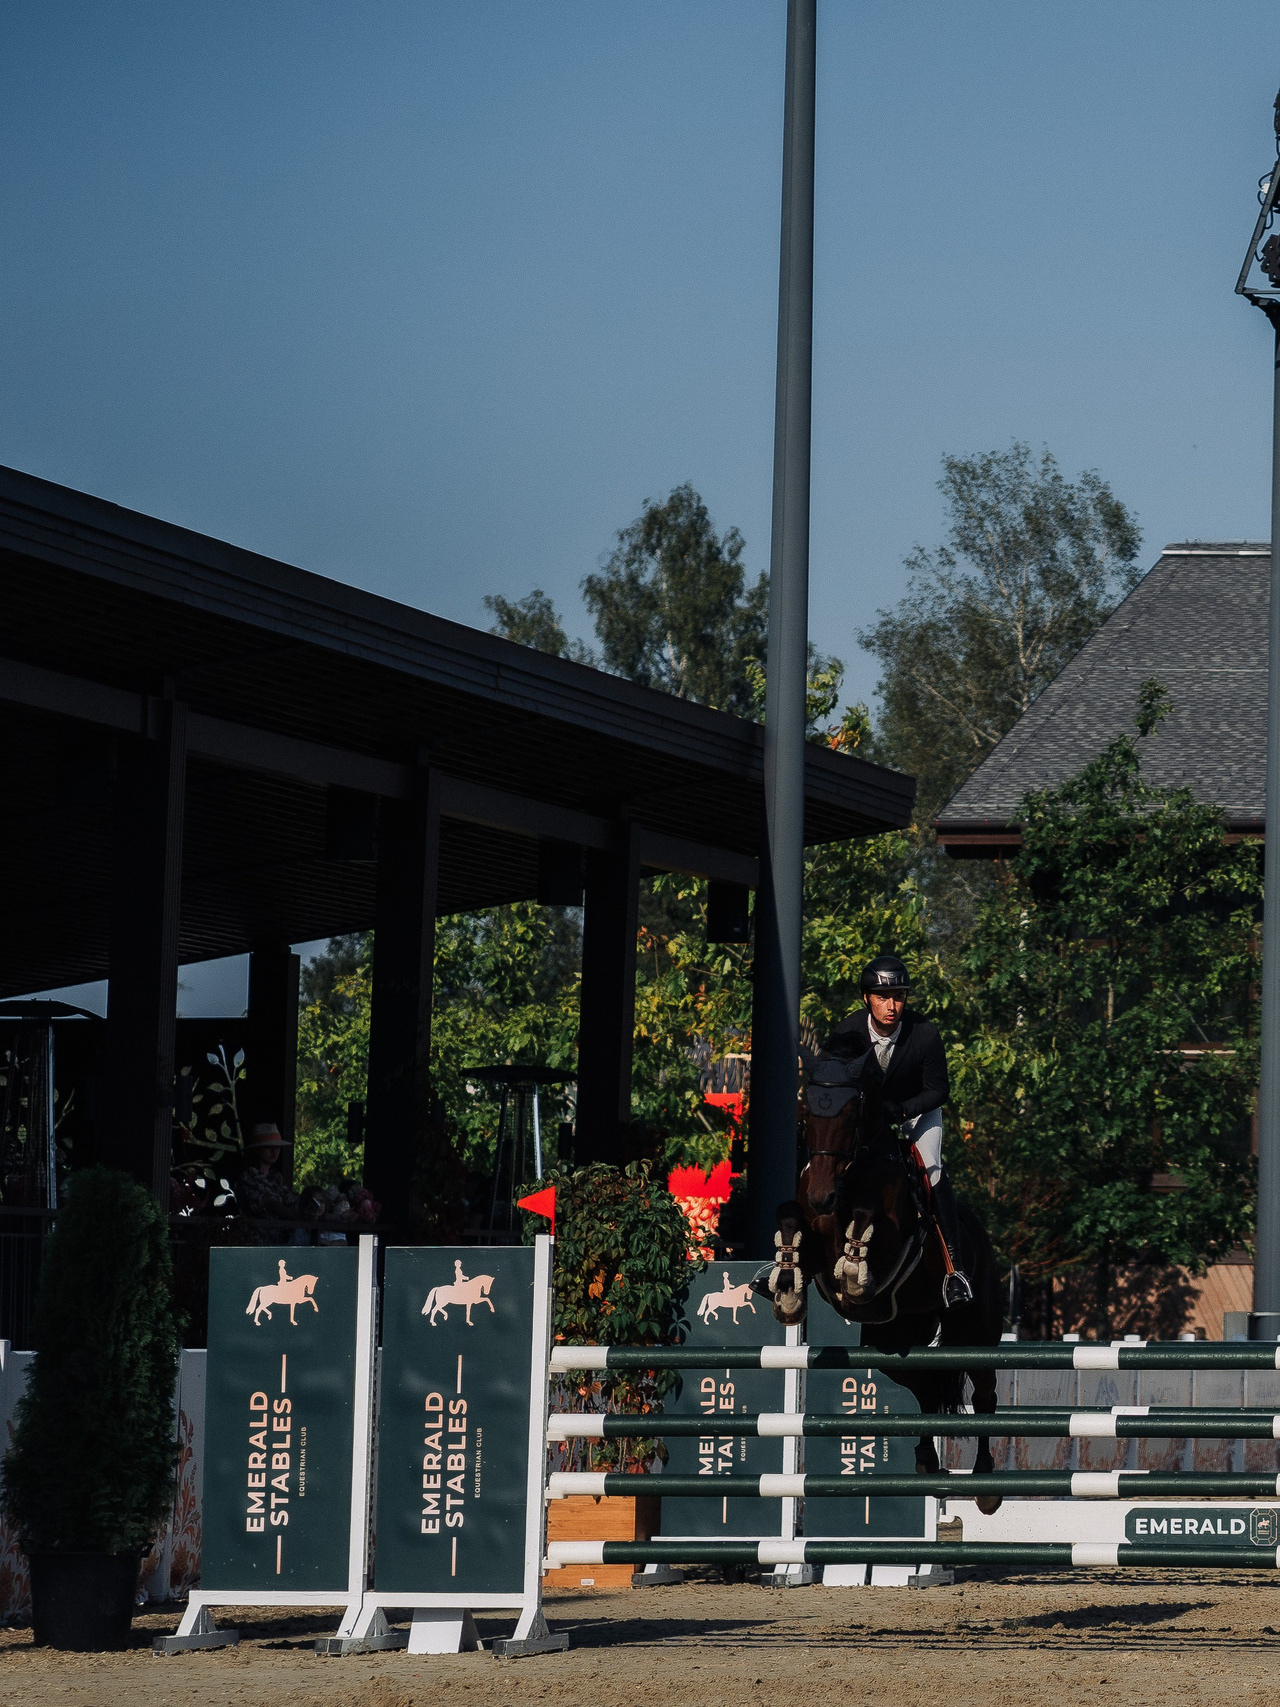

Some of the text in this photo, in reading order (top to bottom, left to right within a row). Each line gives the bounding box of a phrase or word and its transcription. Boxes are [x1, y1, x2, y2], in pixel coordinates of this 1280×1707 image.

[246, 1390, 269, 1532] EMERALD
[269, 1397, 292, 1526] STABLES
[298, 1426, 308, 1497] EQUESTRIAN CLUB
[421, 1391, 444, 1534] EMERALD
[445, 1398, 468, 1528] STABLES
[474, 1427, 484, 1499] EQUESTRIAN CLUB
[697, 1376, 716, 1475] MELD
[717, 1382, 735, 1475] TAES
[840, 1377, 858, 1475] MELD
[859, 1382, 877, 1475] TAES
[1135, 1518, 1246, 1535] EMERALD
